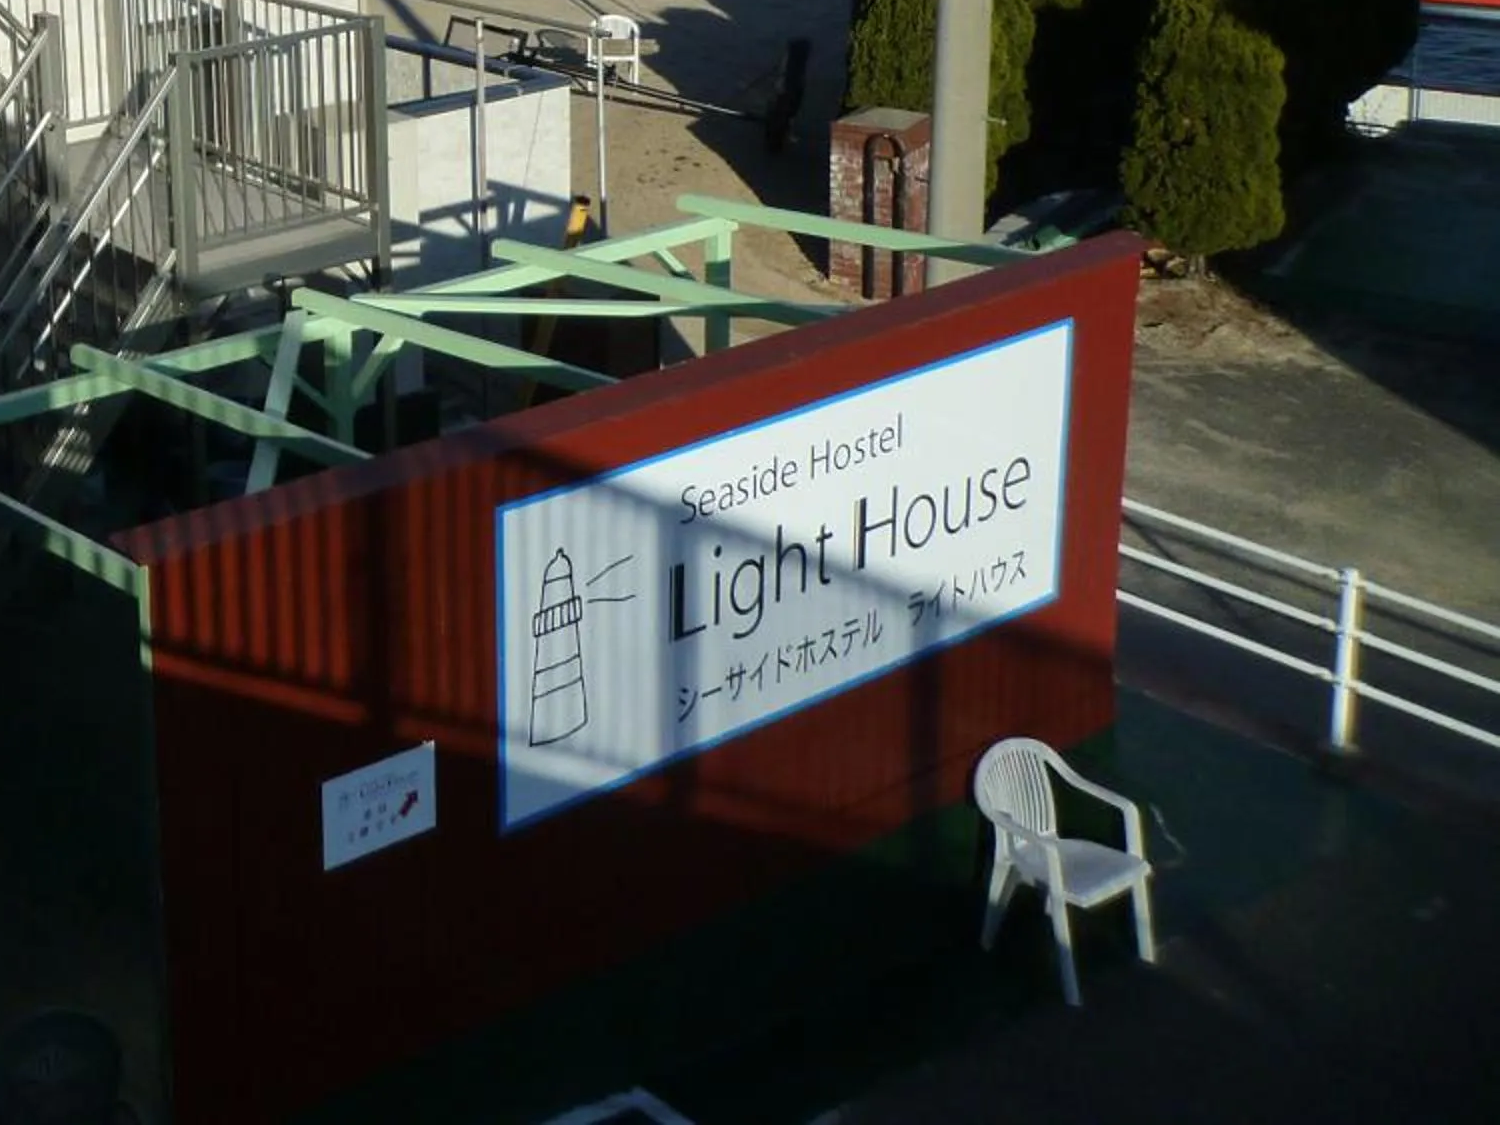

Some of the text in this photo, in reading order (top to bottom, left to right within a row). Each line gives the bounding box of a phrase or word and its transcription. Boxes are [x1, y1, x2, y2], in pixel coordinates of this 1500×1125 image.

[669, 456, 1031, 642] Light House
[680, 414, 902, 524] Seaside Hostel
[678, 551, 1026, 723] シーサイドホステル ライトハウス
